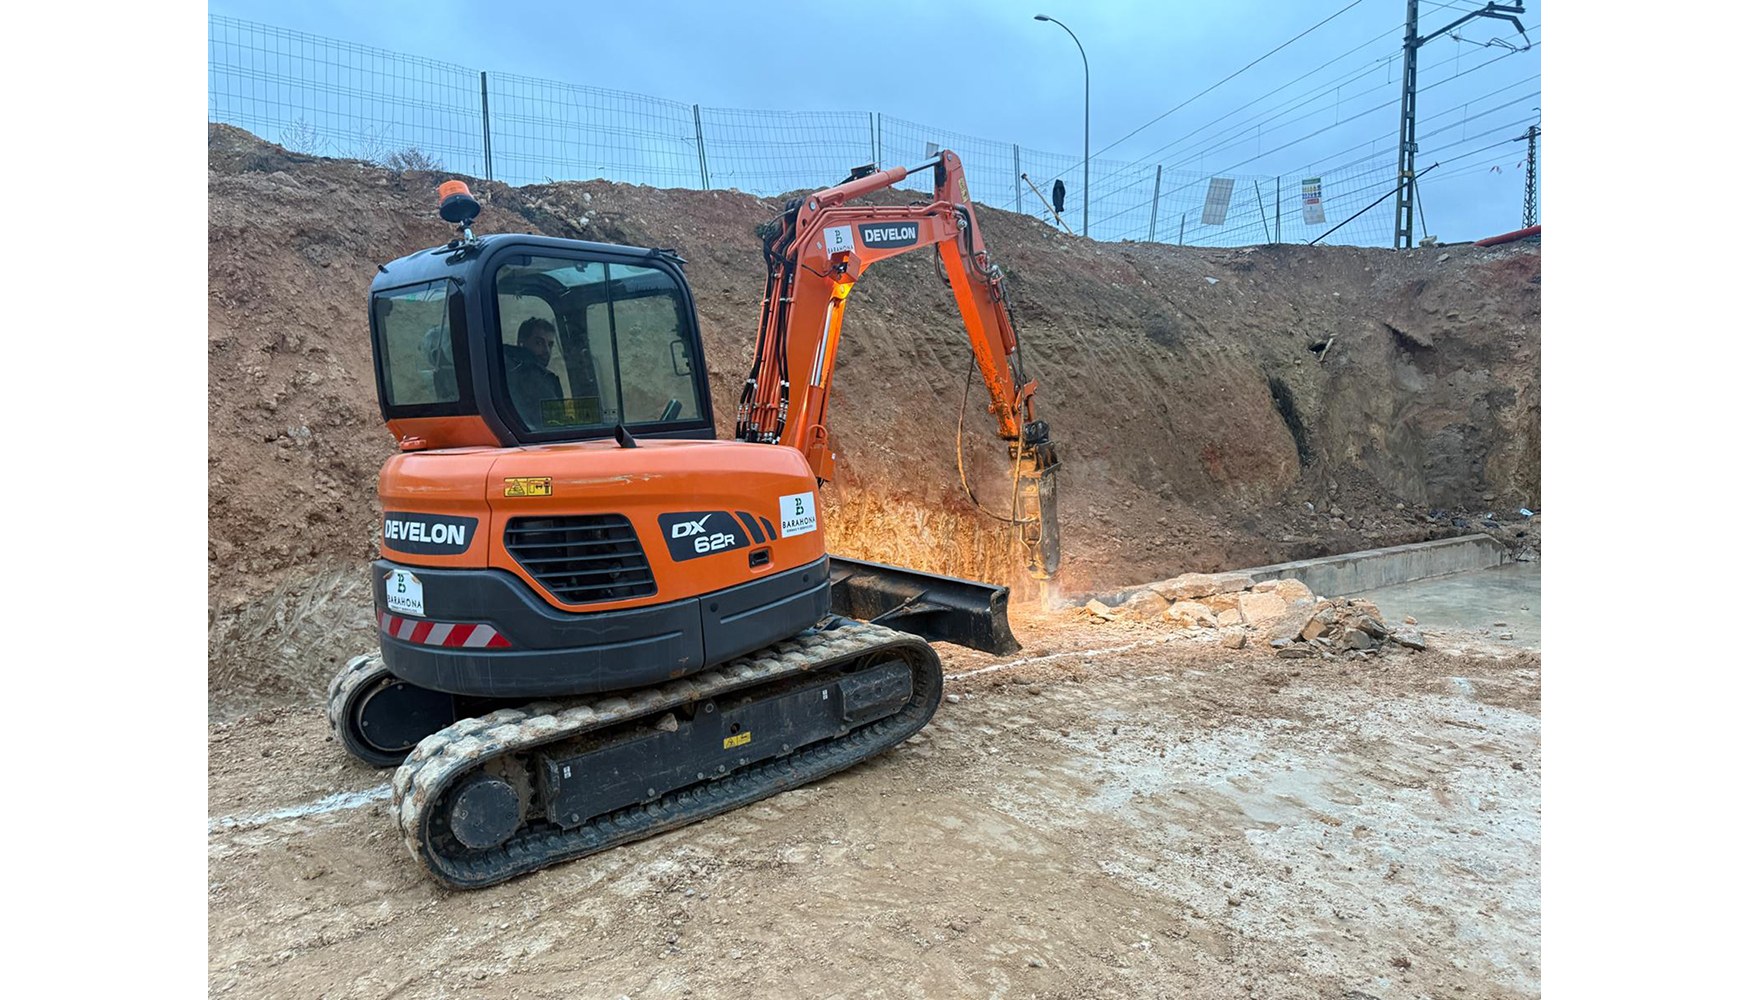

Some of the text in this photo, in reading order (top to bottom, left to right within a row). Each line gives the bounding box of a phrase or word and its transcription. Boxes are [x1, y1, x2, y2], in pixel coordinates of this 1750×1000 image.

[864, 227, 916, 242] DEVELON
[671, 513, 712, 539] DX
[782, 516, 815, 528] BARAHONA
[385, 519, 465, 545] DEVELON
[694, 532, 735, 553] 62R
[387, 595, 421, 608] BARAHONA
